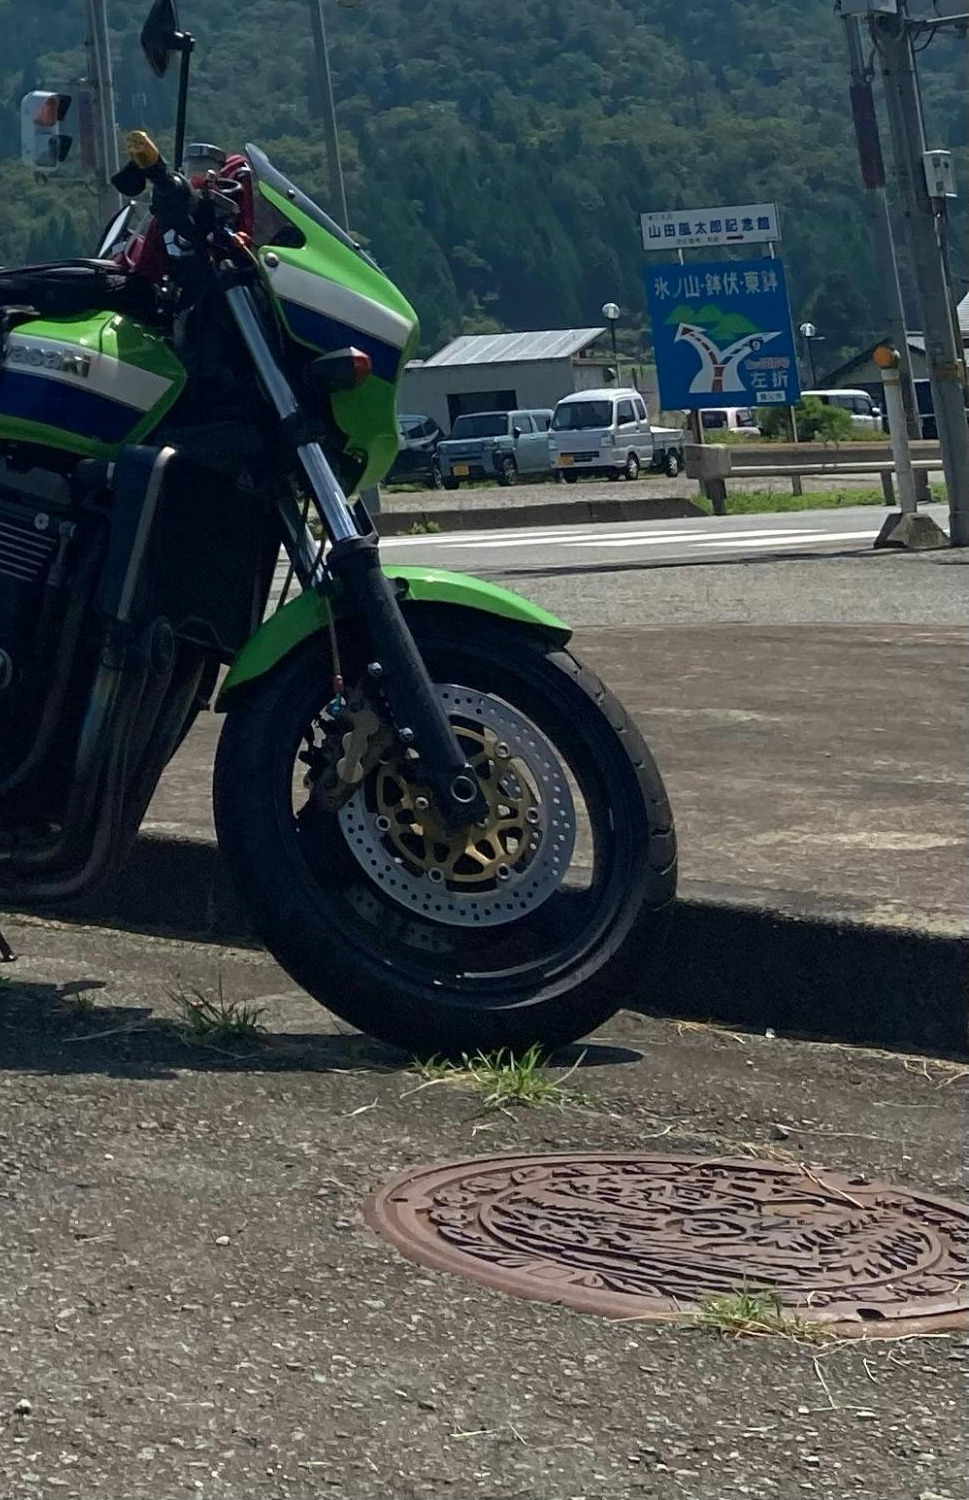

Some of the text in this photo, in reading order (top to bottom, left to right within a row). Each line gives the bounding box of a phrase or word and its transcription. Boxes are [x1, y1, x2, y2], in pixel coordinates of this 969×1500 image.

[752, 340, 761, 351] 9
[4, 345, 92, 378] asaki
[750, 370, 788, 388] 左折
